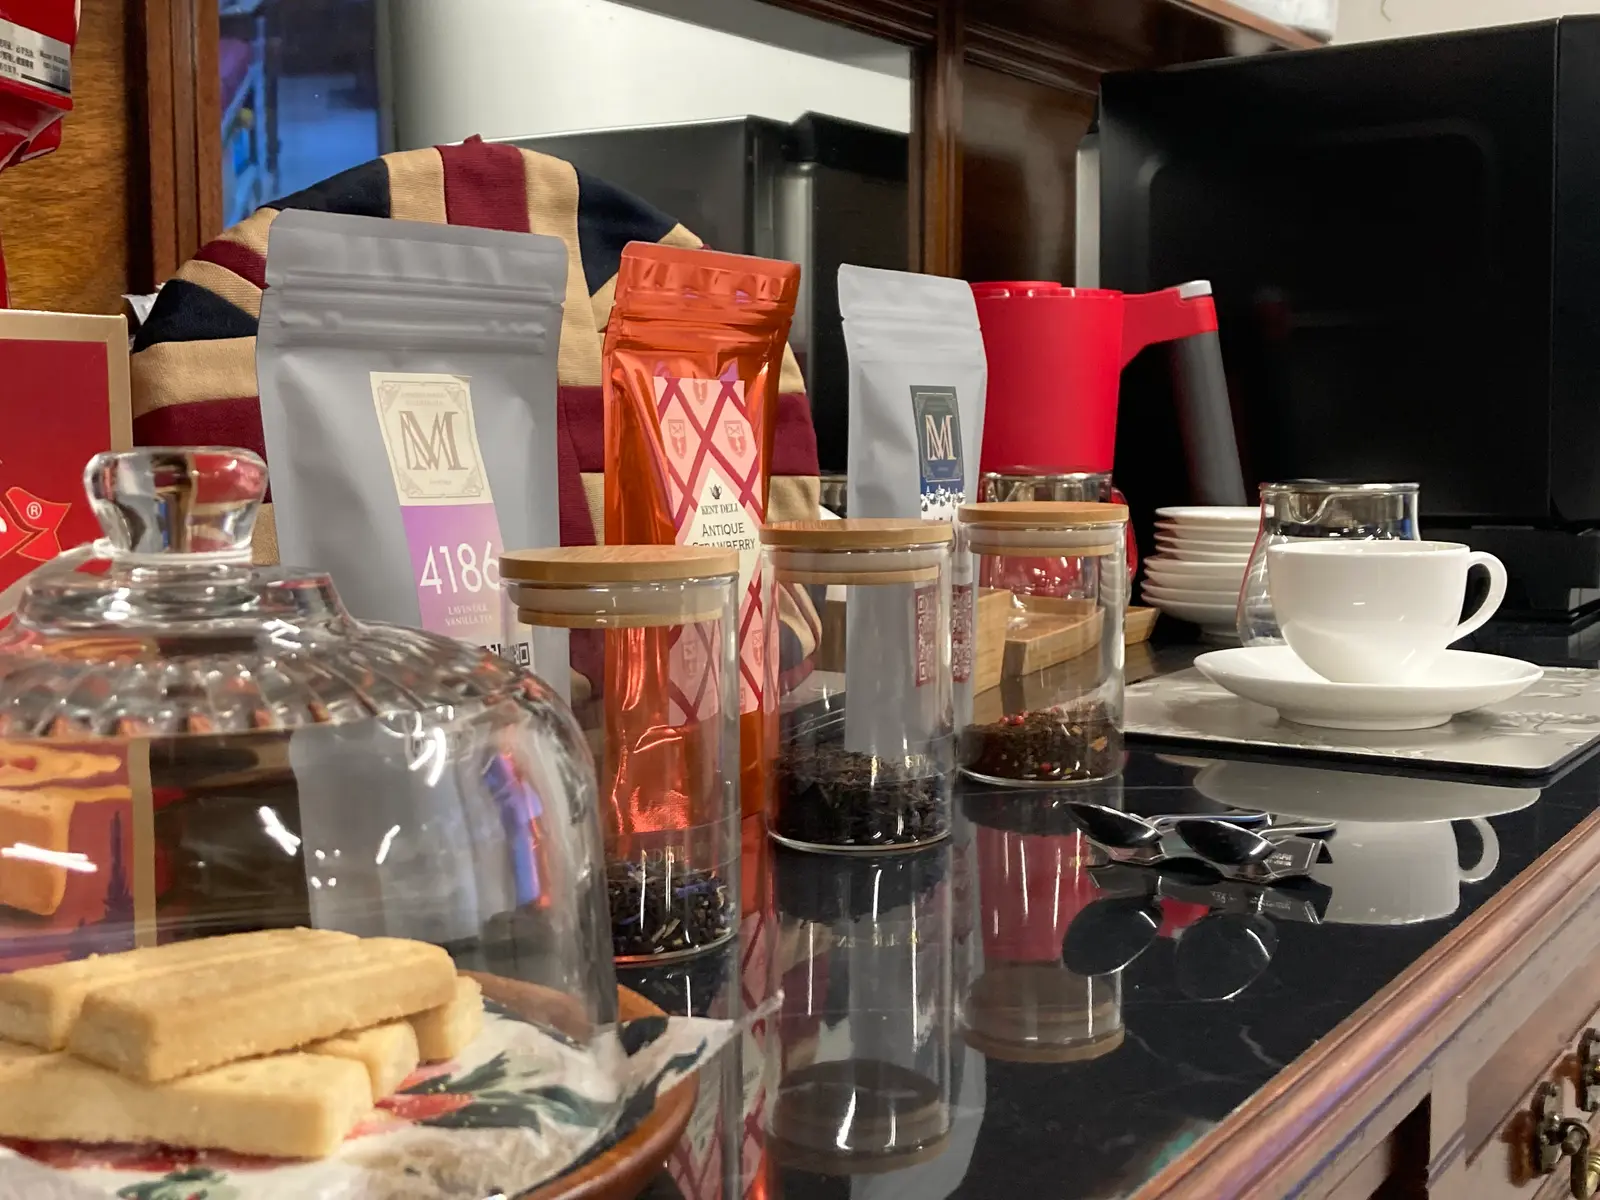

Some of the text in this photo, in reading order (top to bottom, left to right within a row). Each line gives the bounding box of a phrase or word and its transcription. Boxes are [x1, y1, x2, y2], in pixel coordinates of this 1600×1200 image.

[700, 503, 739, 515] KENT DELI
[702, 522, 745, 537] ANTIQUE
[692, 537, 756, 550] WBERRY
[420, 541, 500, 594] 4186
